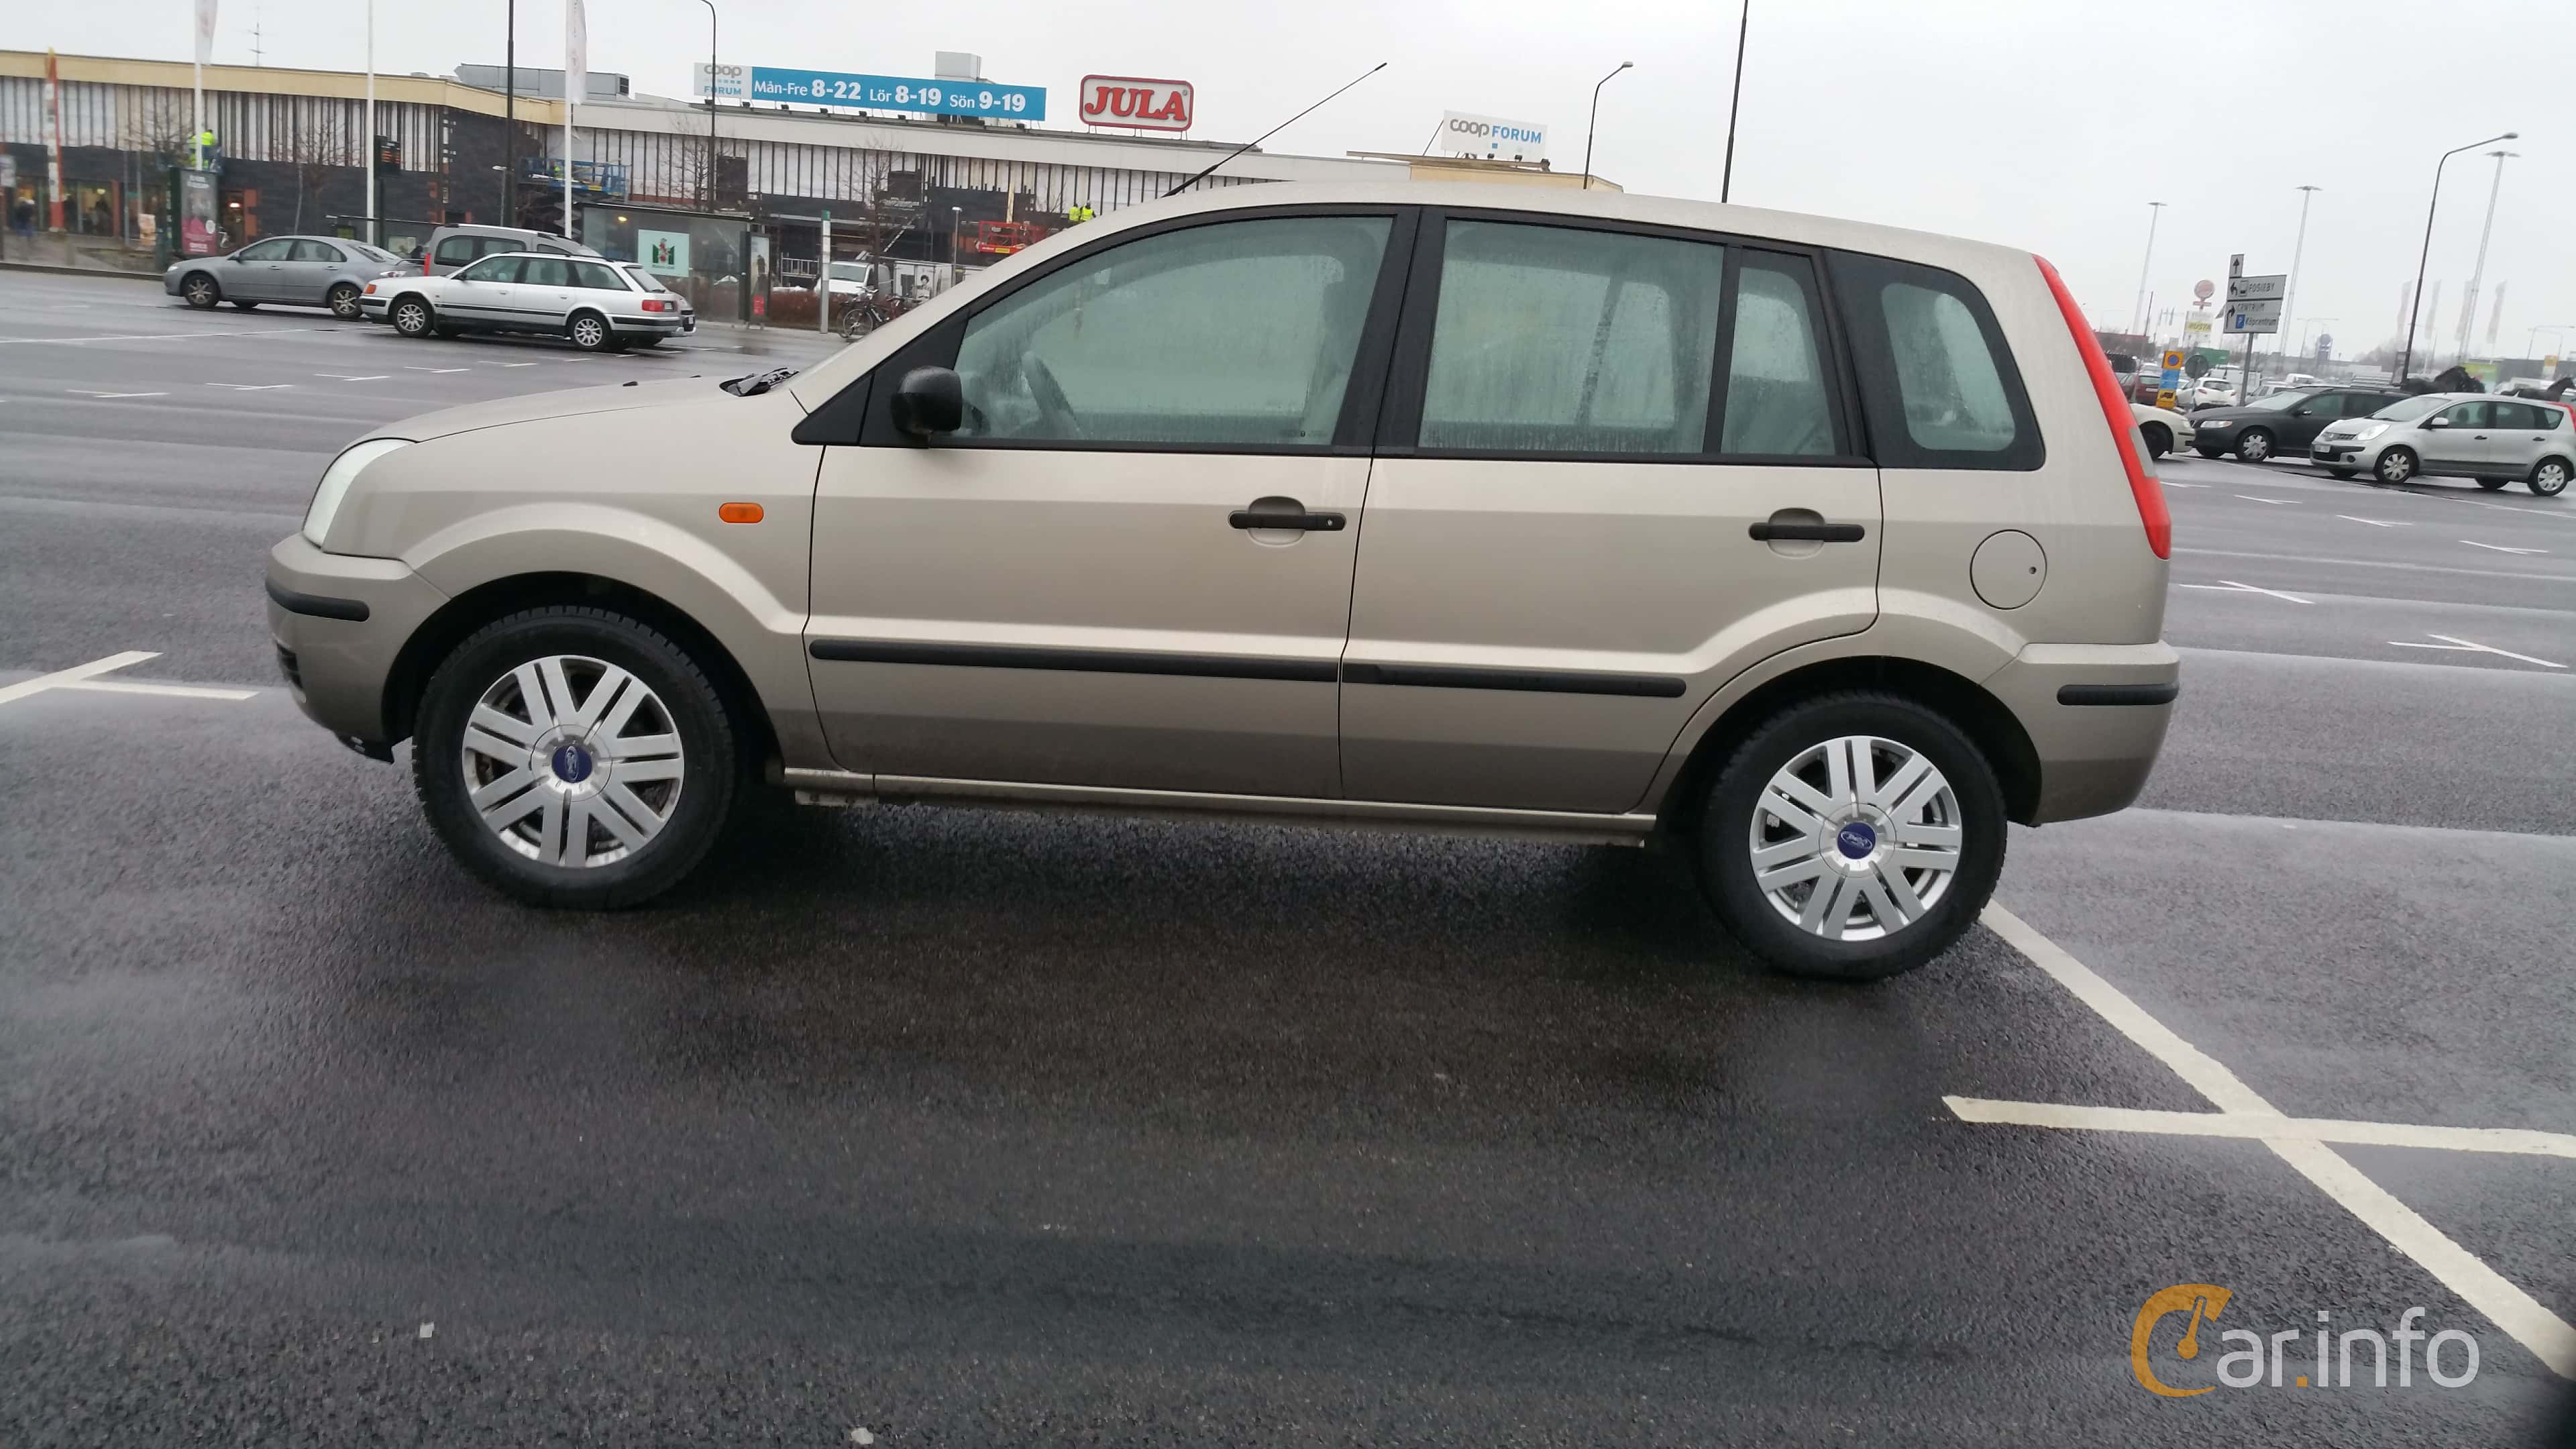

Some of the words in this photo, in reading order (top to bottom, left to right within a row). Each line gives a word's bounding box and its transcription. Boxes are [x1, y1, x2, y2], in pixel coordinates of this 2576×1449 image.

[704, 64, 742, 78] coop
[754, 80, 808, 96] Mån-Fre
[811, 79, 861, 100] 8-22
[869, 88, 892, 103] Lör
[894, 85, 942, 107] 8-19
[949, 94, 975, 108] Sön
[979, 91, 1026, 113] 9-19
[1085, 86, 1187, 121] JULA
[1450, 119, 1490, 138] coop
[1491, 125, 1542, 144] FORUM
